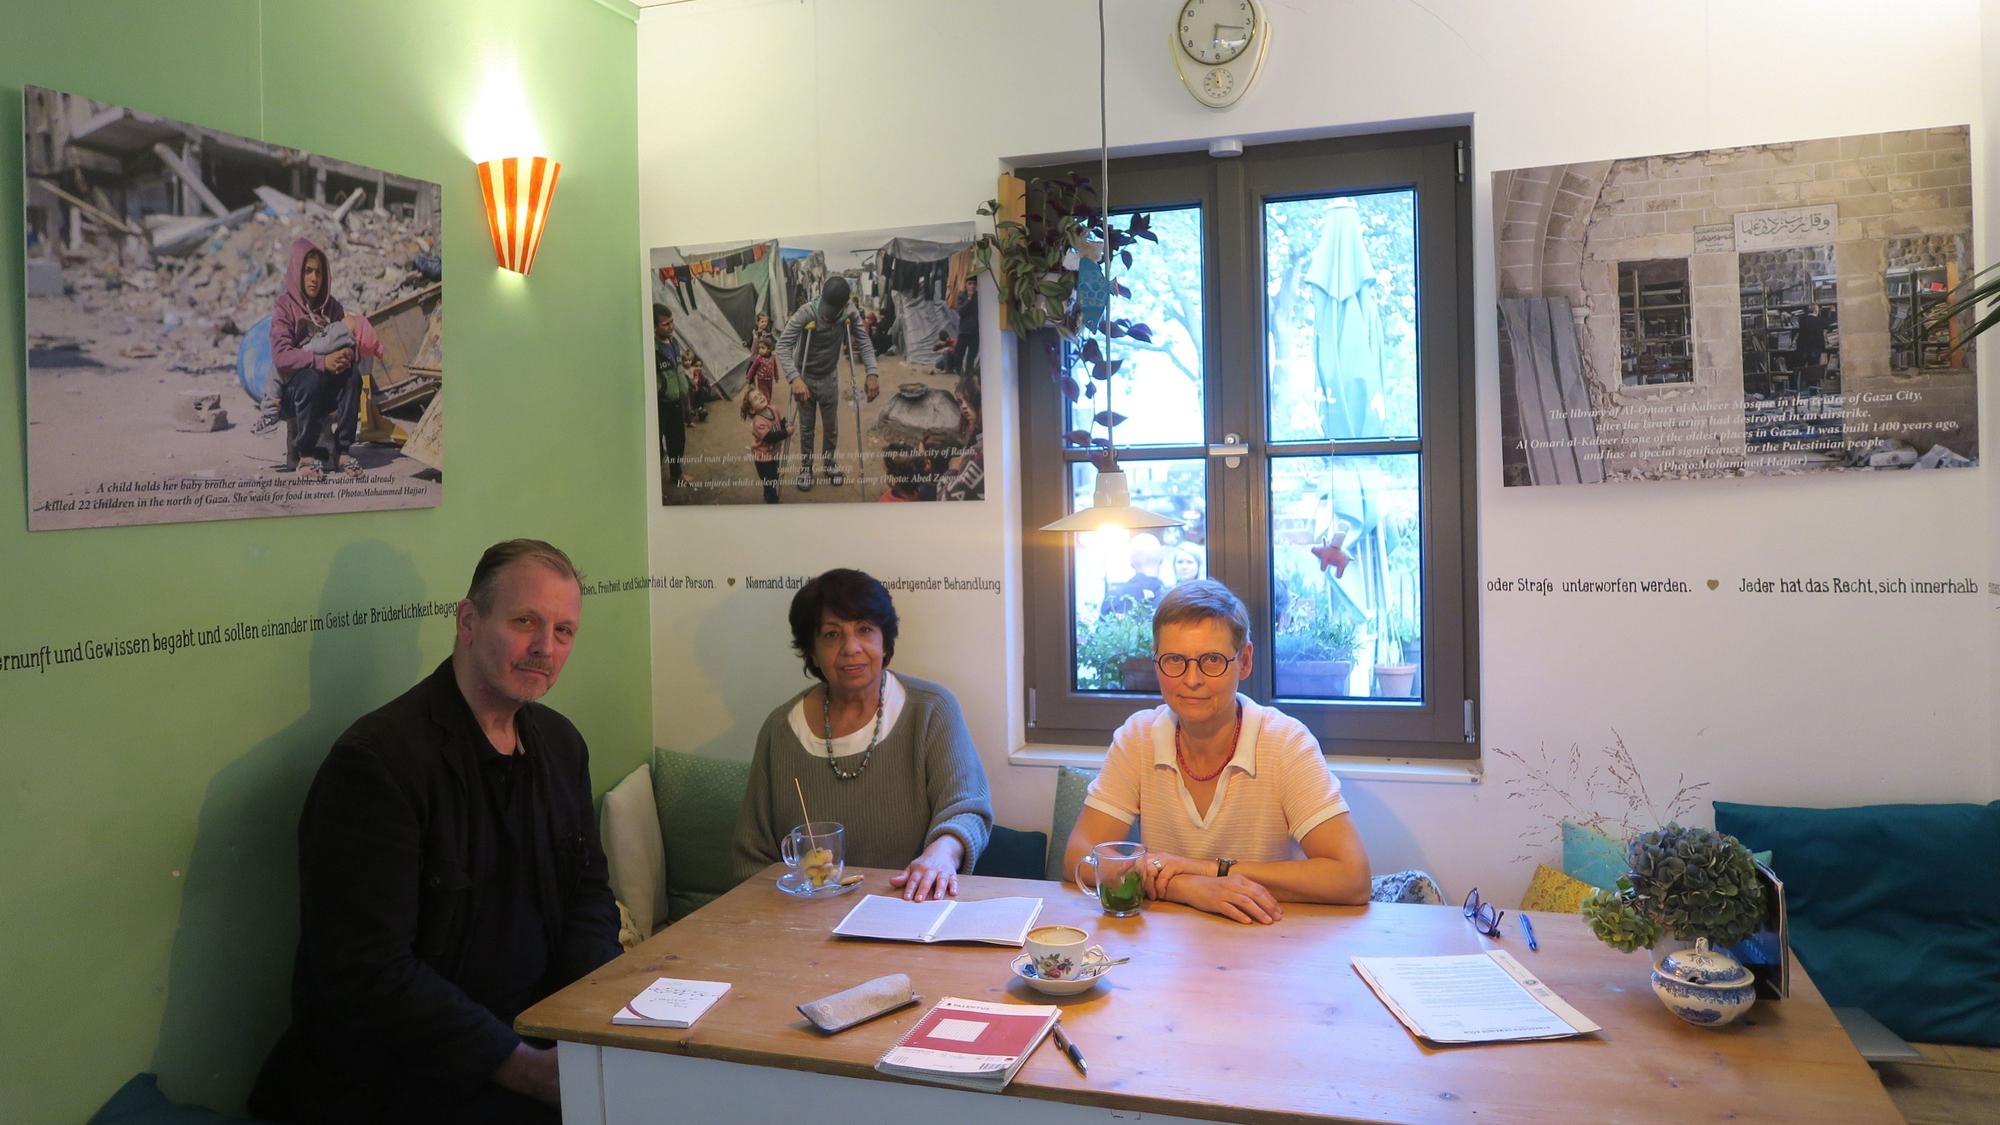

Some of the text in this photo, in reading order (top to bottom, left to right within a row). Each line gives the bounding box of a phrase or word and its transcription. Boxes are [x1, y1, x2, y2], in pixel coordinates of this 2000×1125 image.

[1550, 409, 1568, 419] The
[1570, 408, 1606, 419] library
[1608, 406, 1620, 418] of
[1621, 404, 1674, 415] Al-Omari
[1676, 401, 1730, 413] al-Kabeer
[1732, 400, 1776, 411] Mosque
[1777, 397, 1789, 407] in
[1791, 393, 1809, 406] the
[1848, 393, 1860, 406] of
[1862, 392, 1893, 402] Gaza
[1596, 408, 1872, 432] after the Israeli army had destroyed in an airstrike.
[1516, 439, 1529, 450] Al
[1530, 438, 1565, 449] Omari
[1567, 436, 1619, 447] al-Kabeer
[1621, 434, 1630, 444] is
[1632, 435, 1650, 443] one
[1653, 431, 1666, 444] of
[1667, 430, 1683, 441] the
[1686, 429, 1718, 441] oldest
[1719, 428, 1753, 443] places
[1756, 428, 1768, 438] in
[1770, 426, 1803, 437] Gaza.
[1806, 424, 1816, 434] It
[1818, 425, 1840, 434] was
[1842, 422, 1869, 433] built
[1872, 421, 1900, 432] 1400
[1902, 421, 1933, 433] years
[940, 445, 950, 458] of
[1583, 436, 1885, 461] and has a special significance for the Palestinian people
[97, 482, 105, 493] A
[107, 481, 132, 493] child
[134, 480, 161, 492] holds
[162, 479, 179, 491] her
[180, 479, 202, 492] baby
[204, 478, 236, 490] brother
[237, 476, 273, 490] amongst
[274, 476, 287, 487] the
[370, 474, 395, 485] already
[45, 500, 75, 512] killed
[78, 500, 91, 511] 22
[93, 498, 135, 510] children
[137, 498, 147, 508] in
[149, 495, 164, 507] the
[166, 495, 192, 506] north
[194, 493, 204, 508] of
[205, 493, 231, 505] Gaza.
[233, 491, 248, 503] She
[249, 490, 271, 502] waits
[271, 490, 284, 504] for
[285, 489, 303, 504] food
[304, 489, 312, 500] in
[313, 489, 336, 500] street.
[669, 576, 682, 589] der
[745, 575, 784, 590] Niemand
[943, 576, 1001, 595] Behandlung
[1486, 577, 1692, 597] oder Strafe unterworfen werden.
[1738, 577, 1776, 593] Jeder
[1780, 577, 1804, 593] hat
[1805, 577, 1830, 593] das
[1910, 577, 1979, 594] innerhalb
[54, 642, 84, 665] und
[85, 637, 150, 661] Gewissen
[152, 628, 196, 655] begabt
[198, 625, 221, 646] und
[224, 621, 260, 643] sollen
[261, 618, 307, 638] einander
[309, 614, 324, 632] im
[326, 612, 350, 630] Geist
[352, 610, 368, 627] der
[370, 600, 433, 624] Brüderlichkeit
